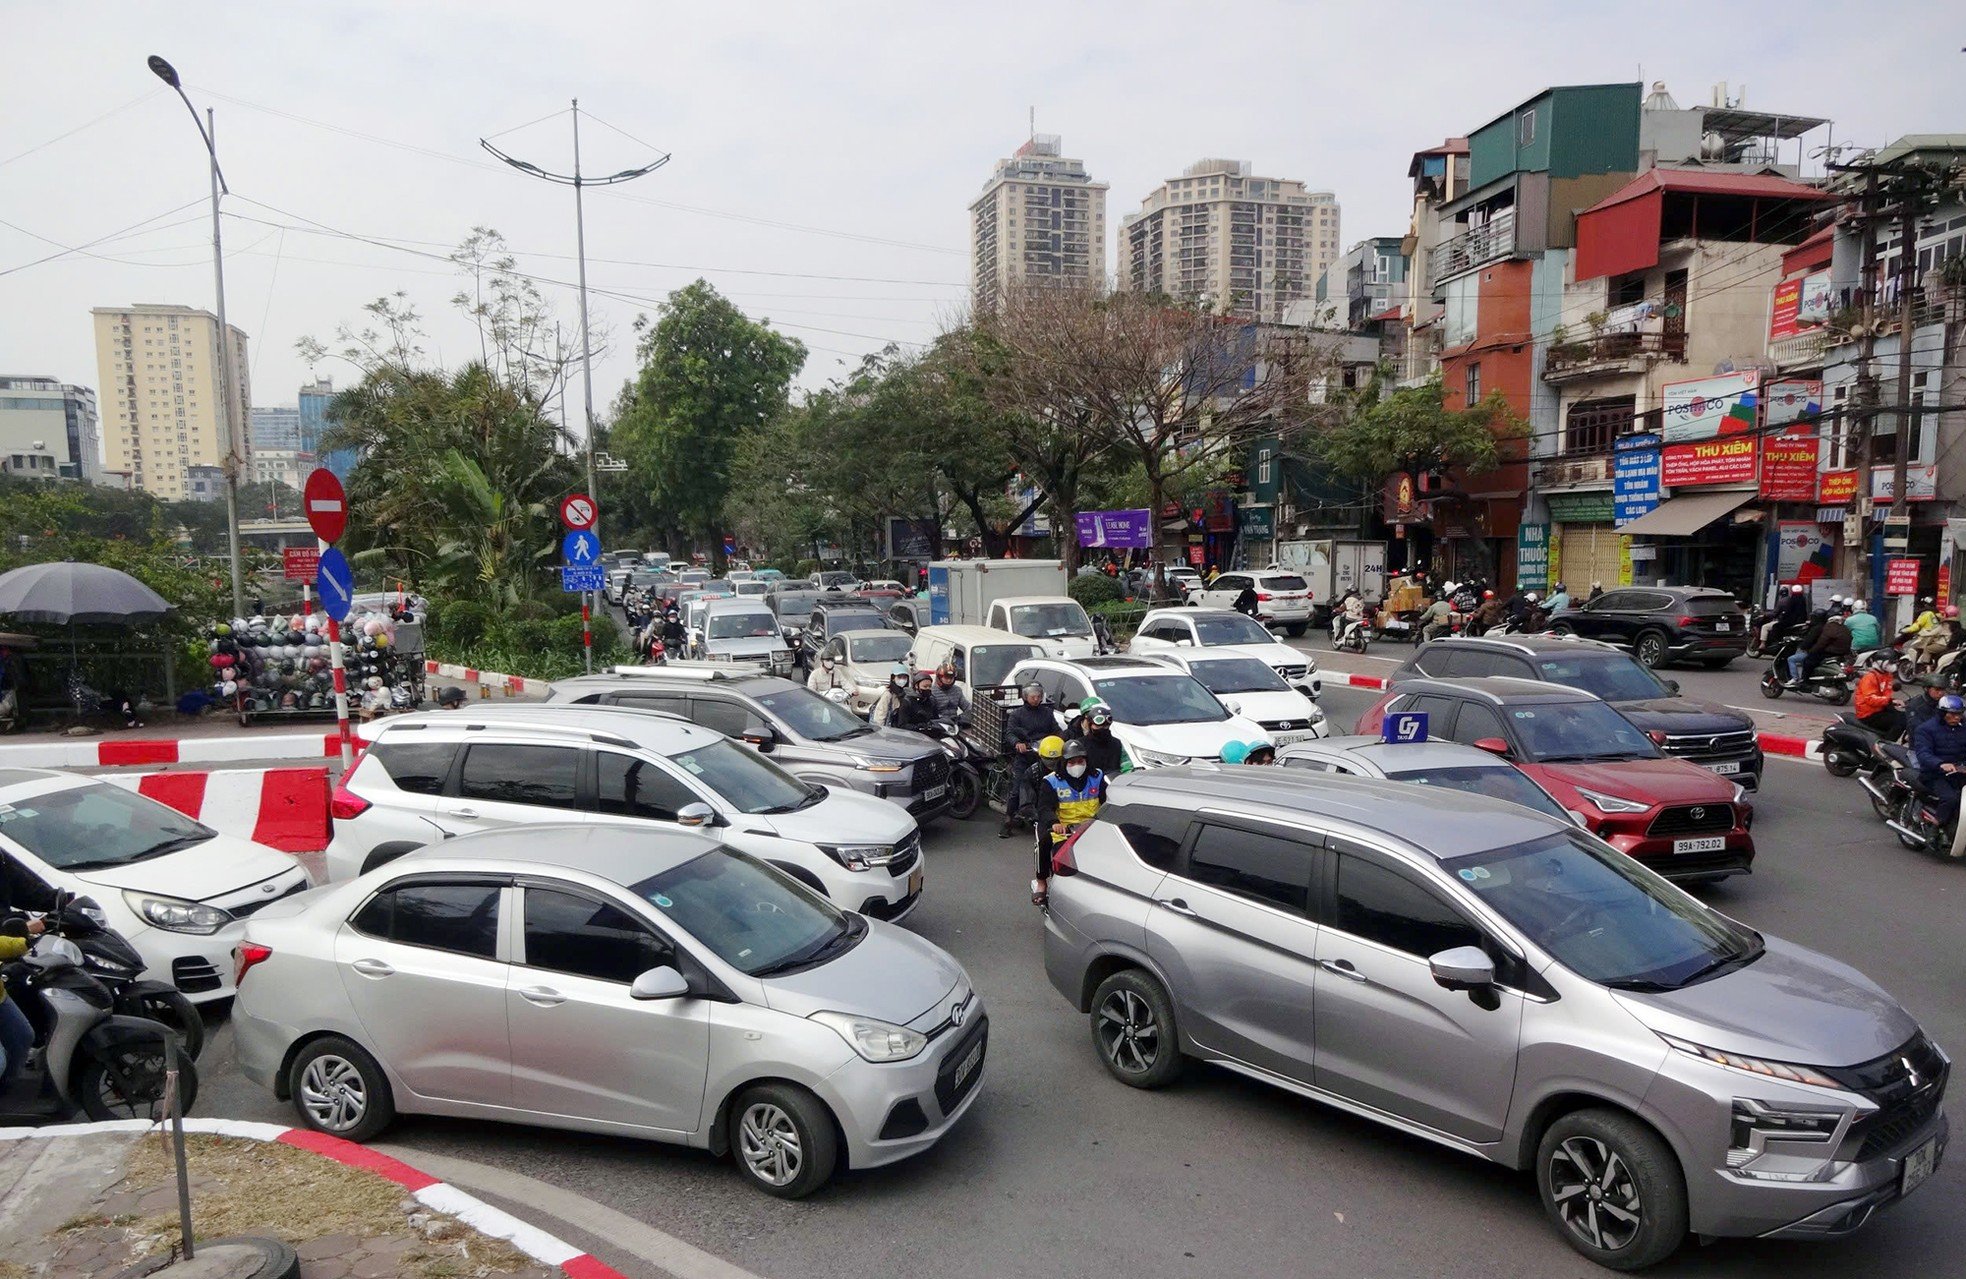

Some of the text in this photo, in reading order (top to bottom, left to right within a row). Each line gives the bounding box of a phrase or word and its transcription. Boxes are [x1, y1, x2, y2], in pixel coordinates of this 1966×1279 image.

[1722, 440, 1752, 456] XIÊM
[1520, 542, 1547, 562] THUỐC
[1399, 717, 1419, 740] G7
[1678, 839, 1721, 851] 99A-792.02
